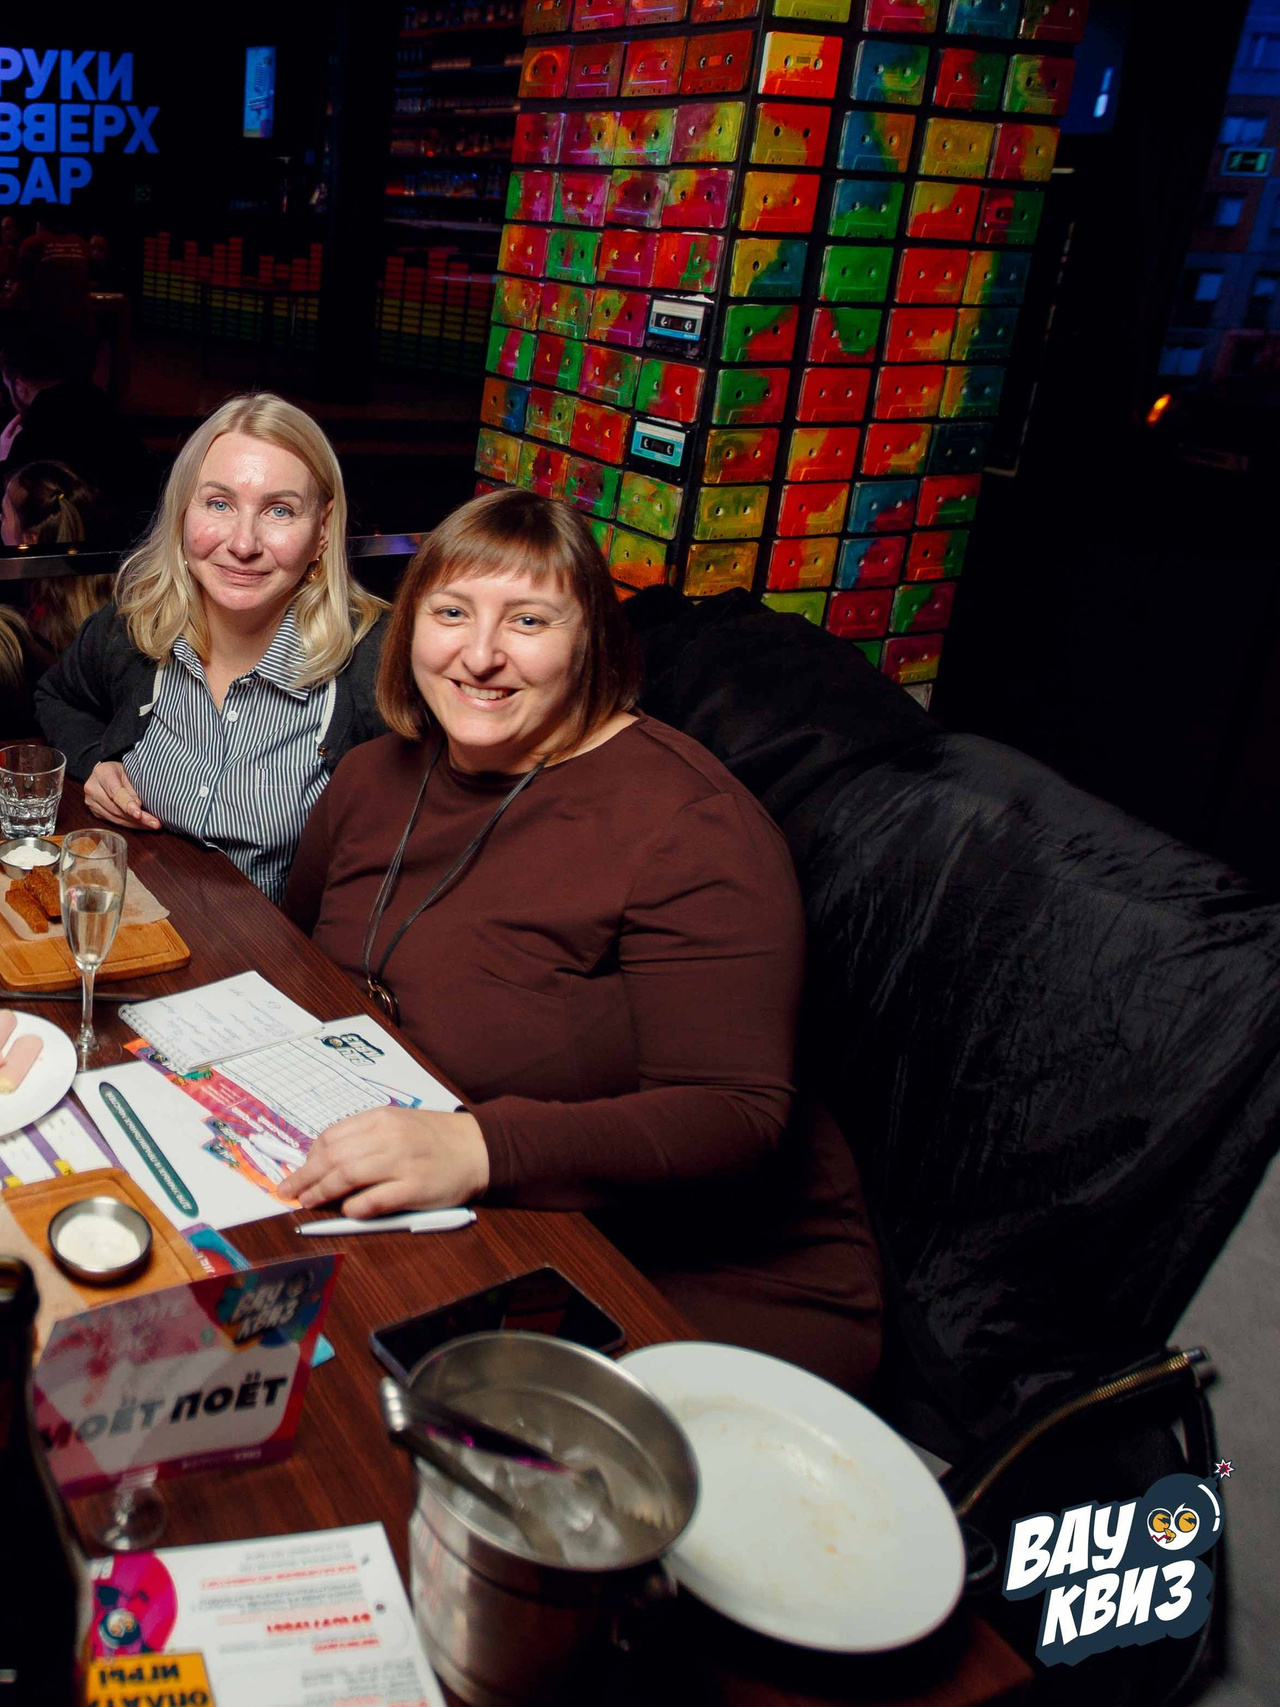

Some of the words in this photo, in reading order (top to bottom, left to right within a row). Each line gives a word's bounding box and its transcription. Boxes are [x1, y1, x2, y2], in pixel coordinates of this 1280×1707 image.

[104, 1089, 128, 1121] МЫСЛЕЙ
[123, 1117, 159, 1165] ПРАВИЛЬНЫХ
[158, 1167, 181, 1197] УМНЫХ
[176, 1193, 193, 1211] ДЛЯ
[169, 1371, 288, 1423] ПОЁТ
[99, 1664, 180, 1687] ИГРЫ
